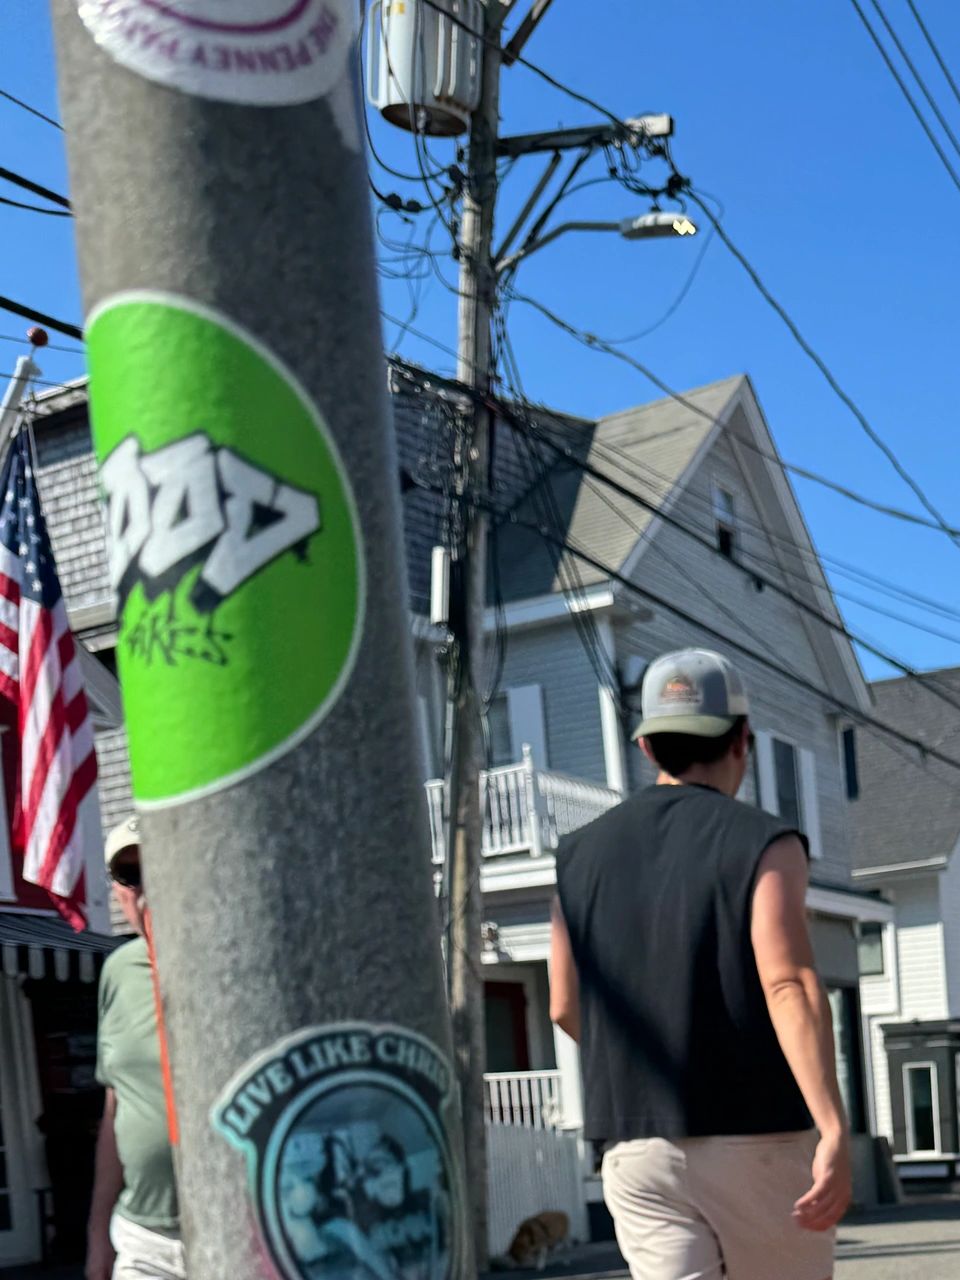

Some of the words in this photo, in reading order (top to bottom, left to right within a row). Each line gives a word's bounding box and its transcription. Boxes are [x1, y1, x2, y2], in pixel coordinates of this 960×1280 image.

[192, 39, 313, 73] PENNEY
[224, 1061, 294, 1135] LIVE
[287, 1035, 373, 1080] LIKE
